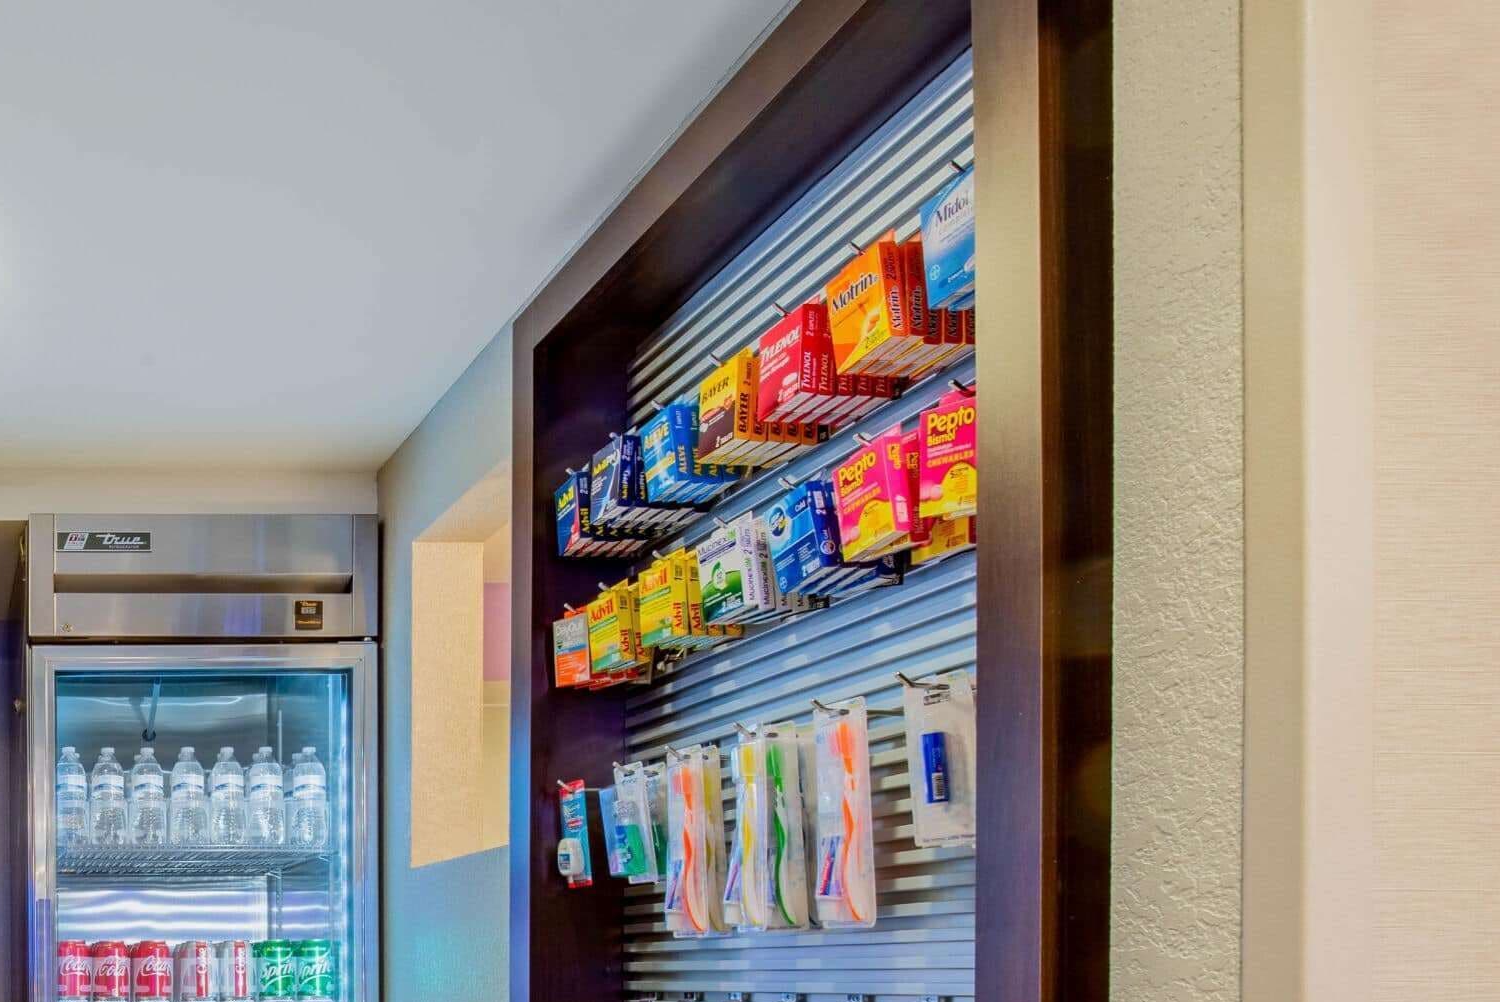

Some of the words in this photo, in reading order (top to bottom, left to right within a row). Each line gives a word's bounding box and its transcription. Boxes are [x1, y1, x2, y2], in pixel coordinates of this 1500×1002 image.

[831, 271, 874, 314] Motrin
[891, 289, 903, 330] Motrin
[760, 327, 800, 368] TYLENOL
[802, 351, 812, 389] TYLENOL
[738, 392, 749, 433] BAYER
[926, 406, 976, 436] Pepto
[838, 451, 877, 489] Pepto
[672, 602, 682, 629] Advil
[620, 629, 629, 654] Advil
